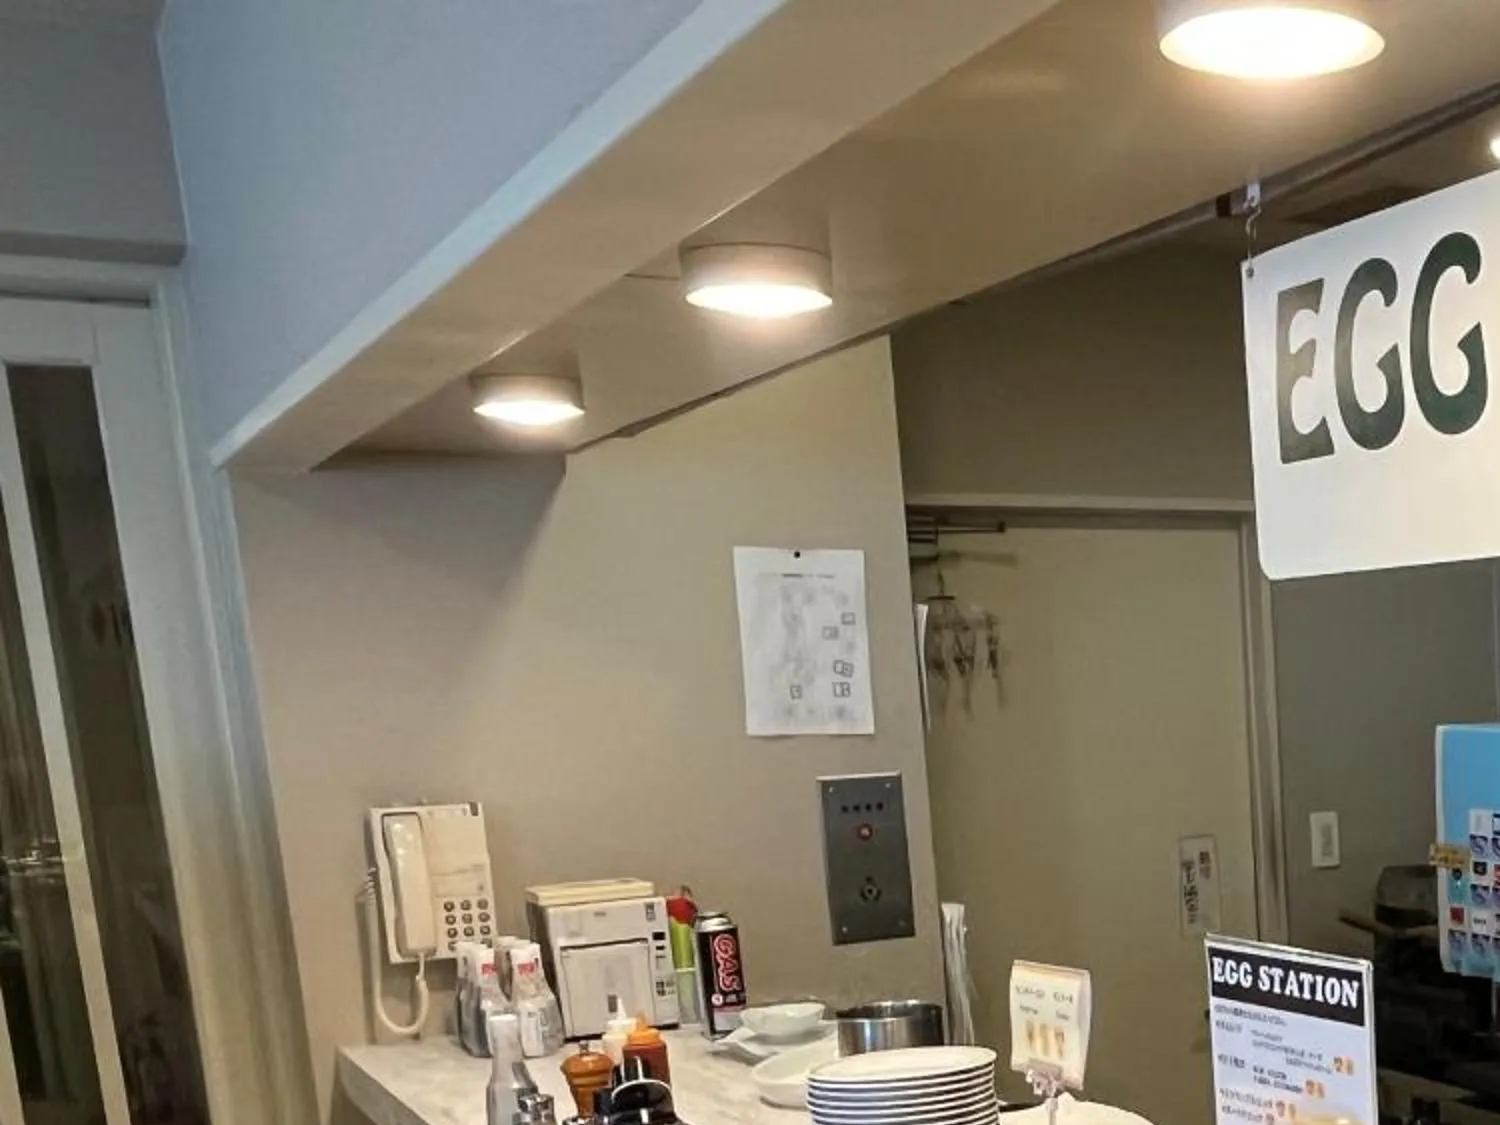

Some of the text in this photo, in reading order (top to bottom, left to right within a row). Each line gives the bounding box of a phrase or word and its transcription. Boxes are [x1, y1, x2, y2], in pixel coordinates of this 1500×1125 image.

[1278, 230, 1489, 465] EGG
[1212, 956, 1360, 1009] EGG STATION
